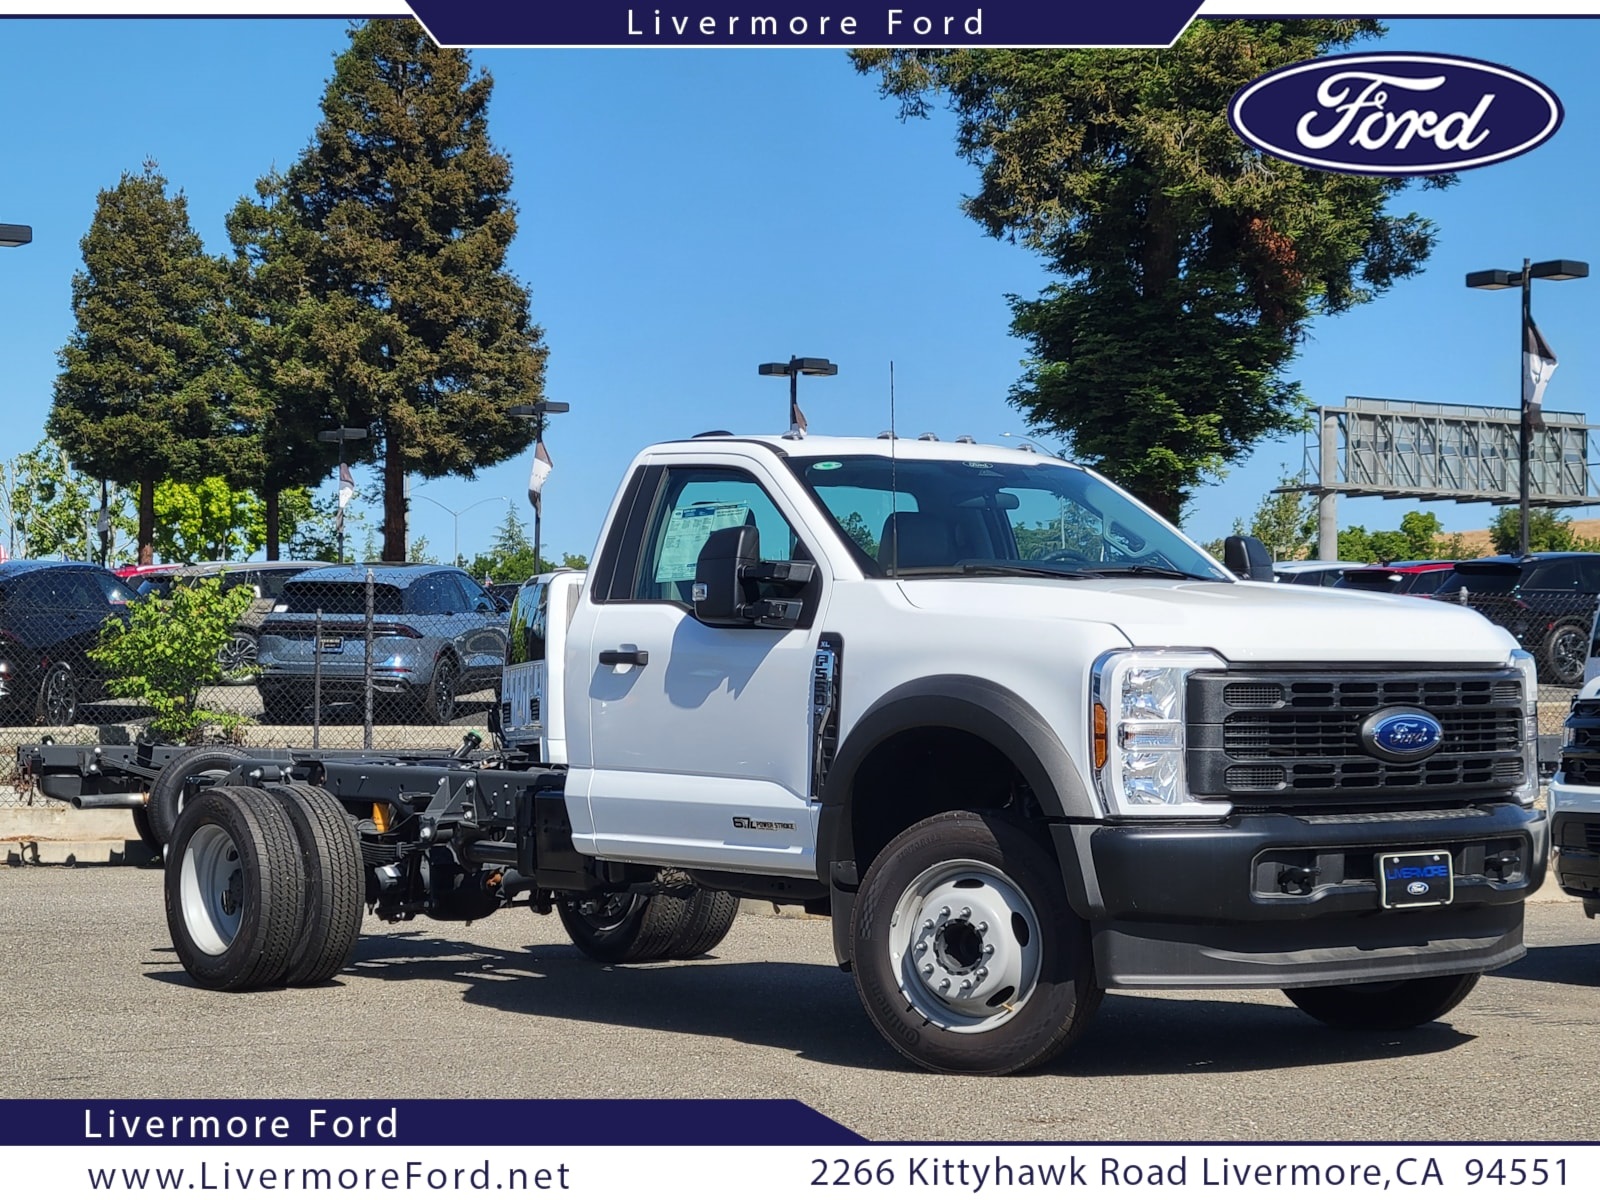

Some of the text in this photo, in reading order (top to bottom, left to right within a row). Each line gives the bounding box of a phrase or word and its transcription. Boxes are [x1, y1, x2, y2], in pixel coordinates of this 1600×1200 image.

[820, 640, 831, 648] XL
[1389, 721, 1428, 745] Ford
[1385, 865, 1449, 880] LIVERMORE
